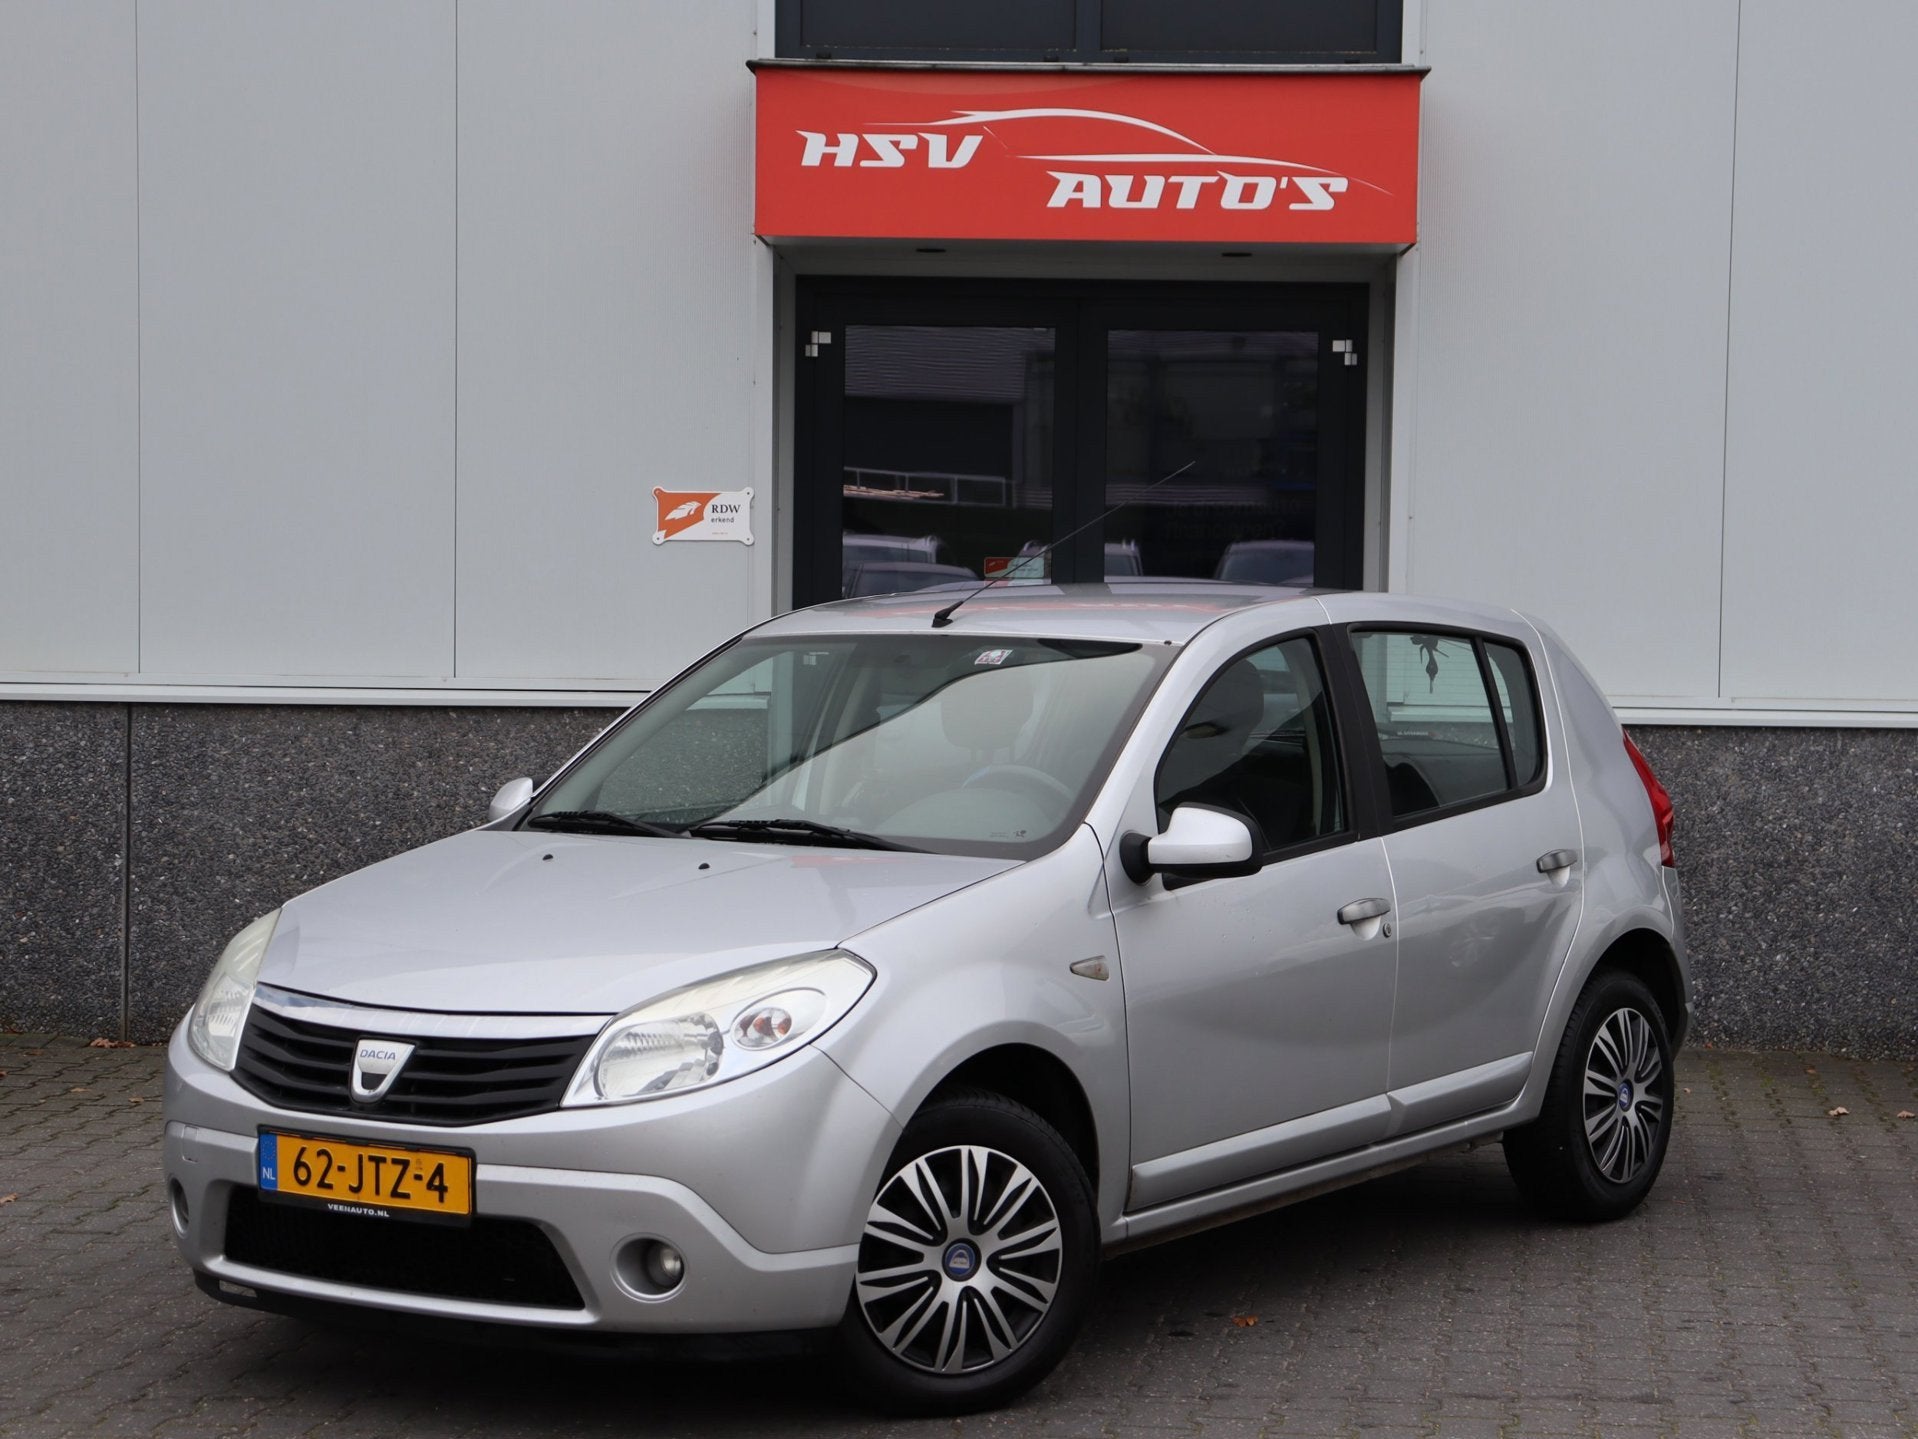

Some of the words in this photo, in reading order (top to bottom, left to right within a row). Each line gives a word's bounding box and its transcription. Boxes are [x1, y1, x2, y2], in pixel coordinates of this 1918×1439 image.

[795, 130, 983, 168] HSV
[1046, 171, 1348, 210] AUTO'S
[711, 504, 741, 514] RDW
[360, 1049, 396, 1061] DACIA
[262, 1166, 276, 1181] NL
[293, 1146, 448, 1203] 62-JTZ-4
